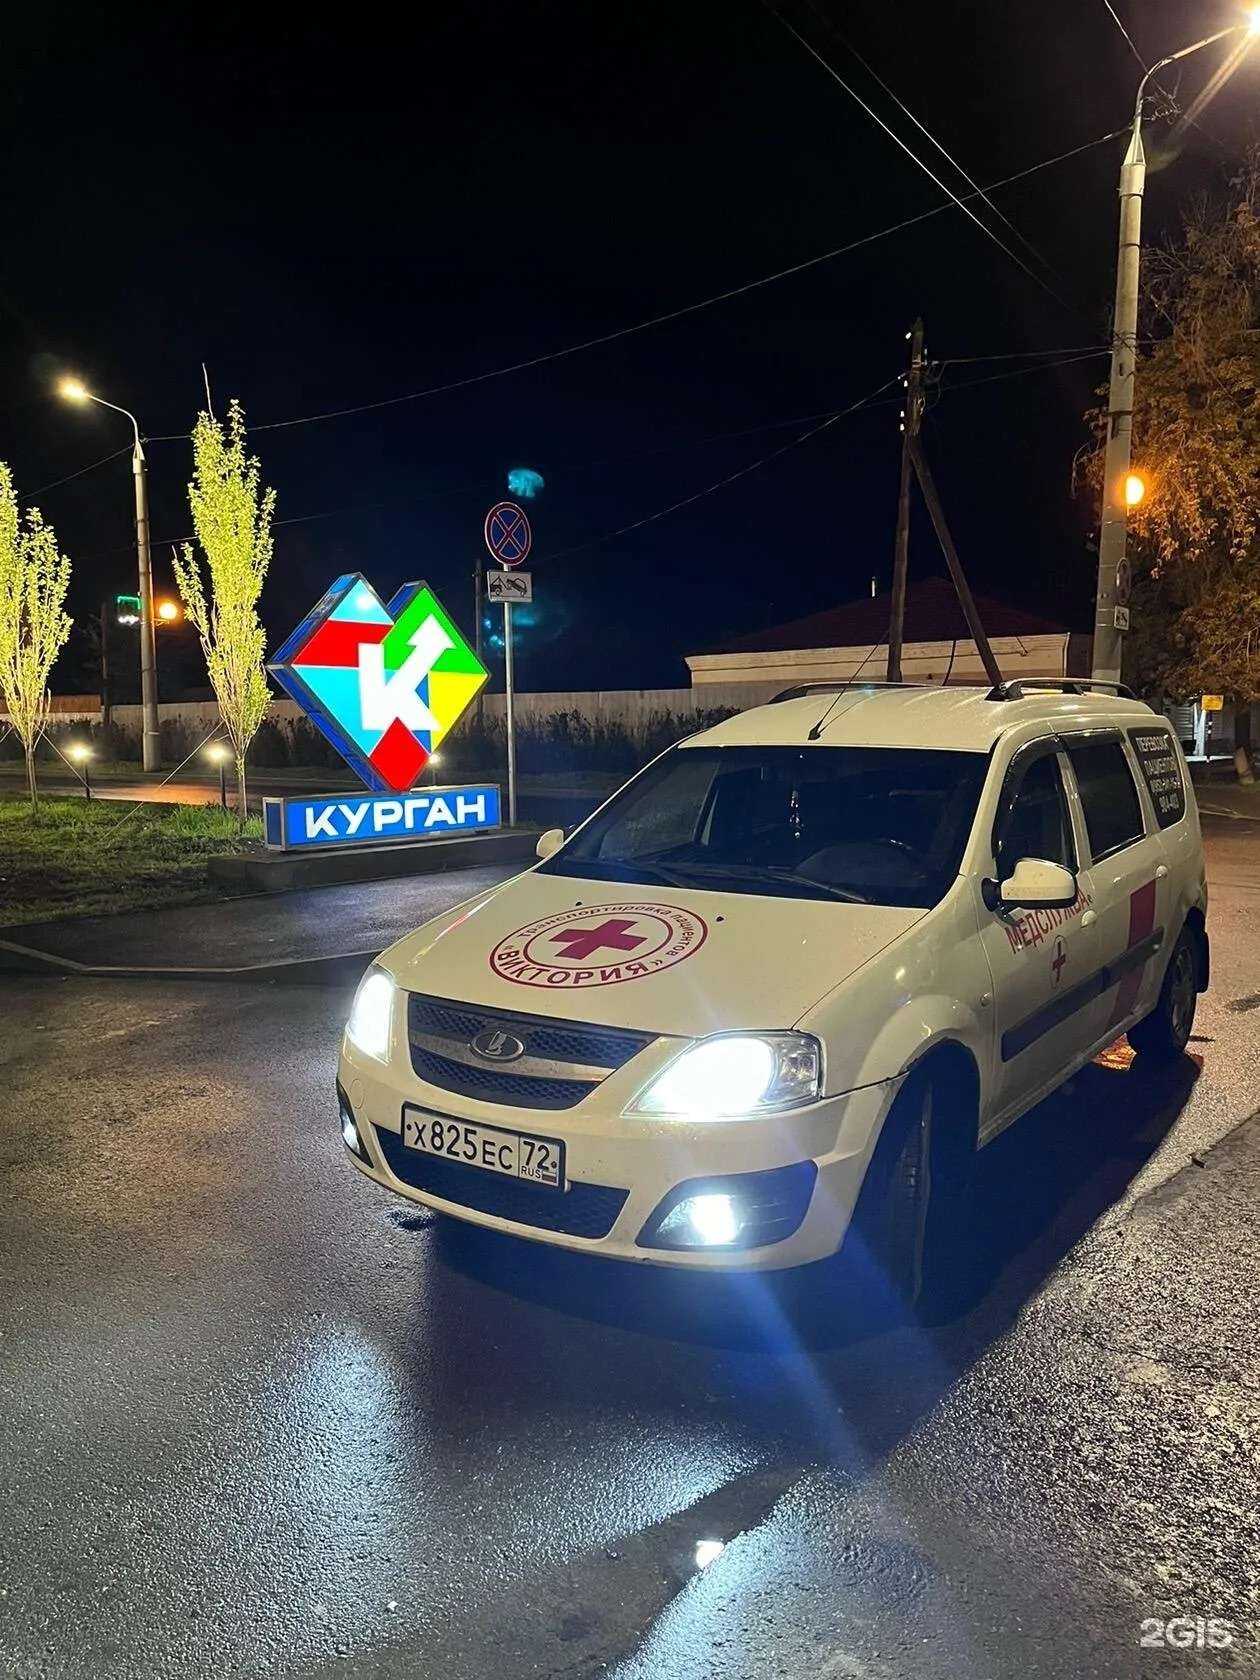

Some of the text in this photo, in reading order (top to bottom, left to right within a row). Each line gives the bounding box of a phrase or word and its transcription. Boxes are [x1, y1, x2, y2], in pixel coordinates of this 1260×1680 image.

[305, 794, 486, 839] КУРГАН
[665, 914, 695, 957] пациентов
[520, 1165, 542, 1179] RUS
[523, 1140, 550, 1171] 72
